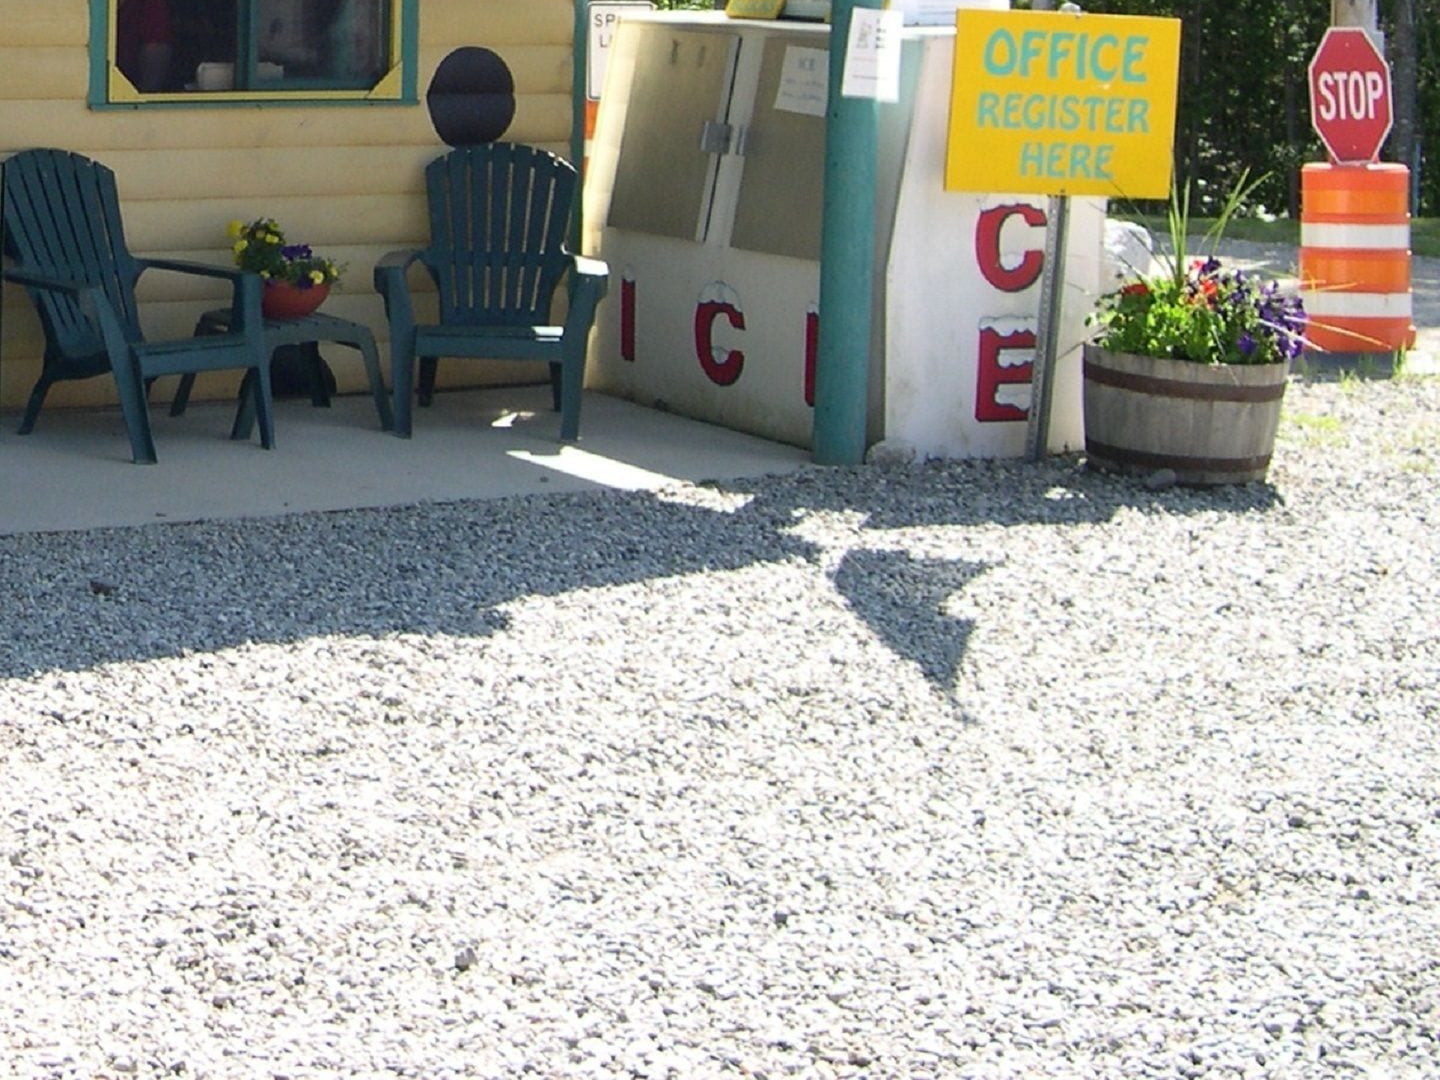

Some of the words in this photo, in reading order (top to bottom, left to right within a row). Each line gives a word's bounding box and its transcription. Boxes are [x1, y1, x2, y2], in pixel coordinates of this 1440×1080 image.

[983, 28, 1150, 83] OFFICE
[976, 92, 1150, 134] REGISTER
[1318, 70, 1384, 121] STOP
[1019, 142, 1115, 179] HERE
